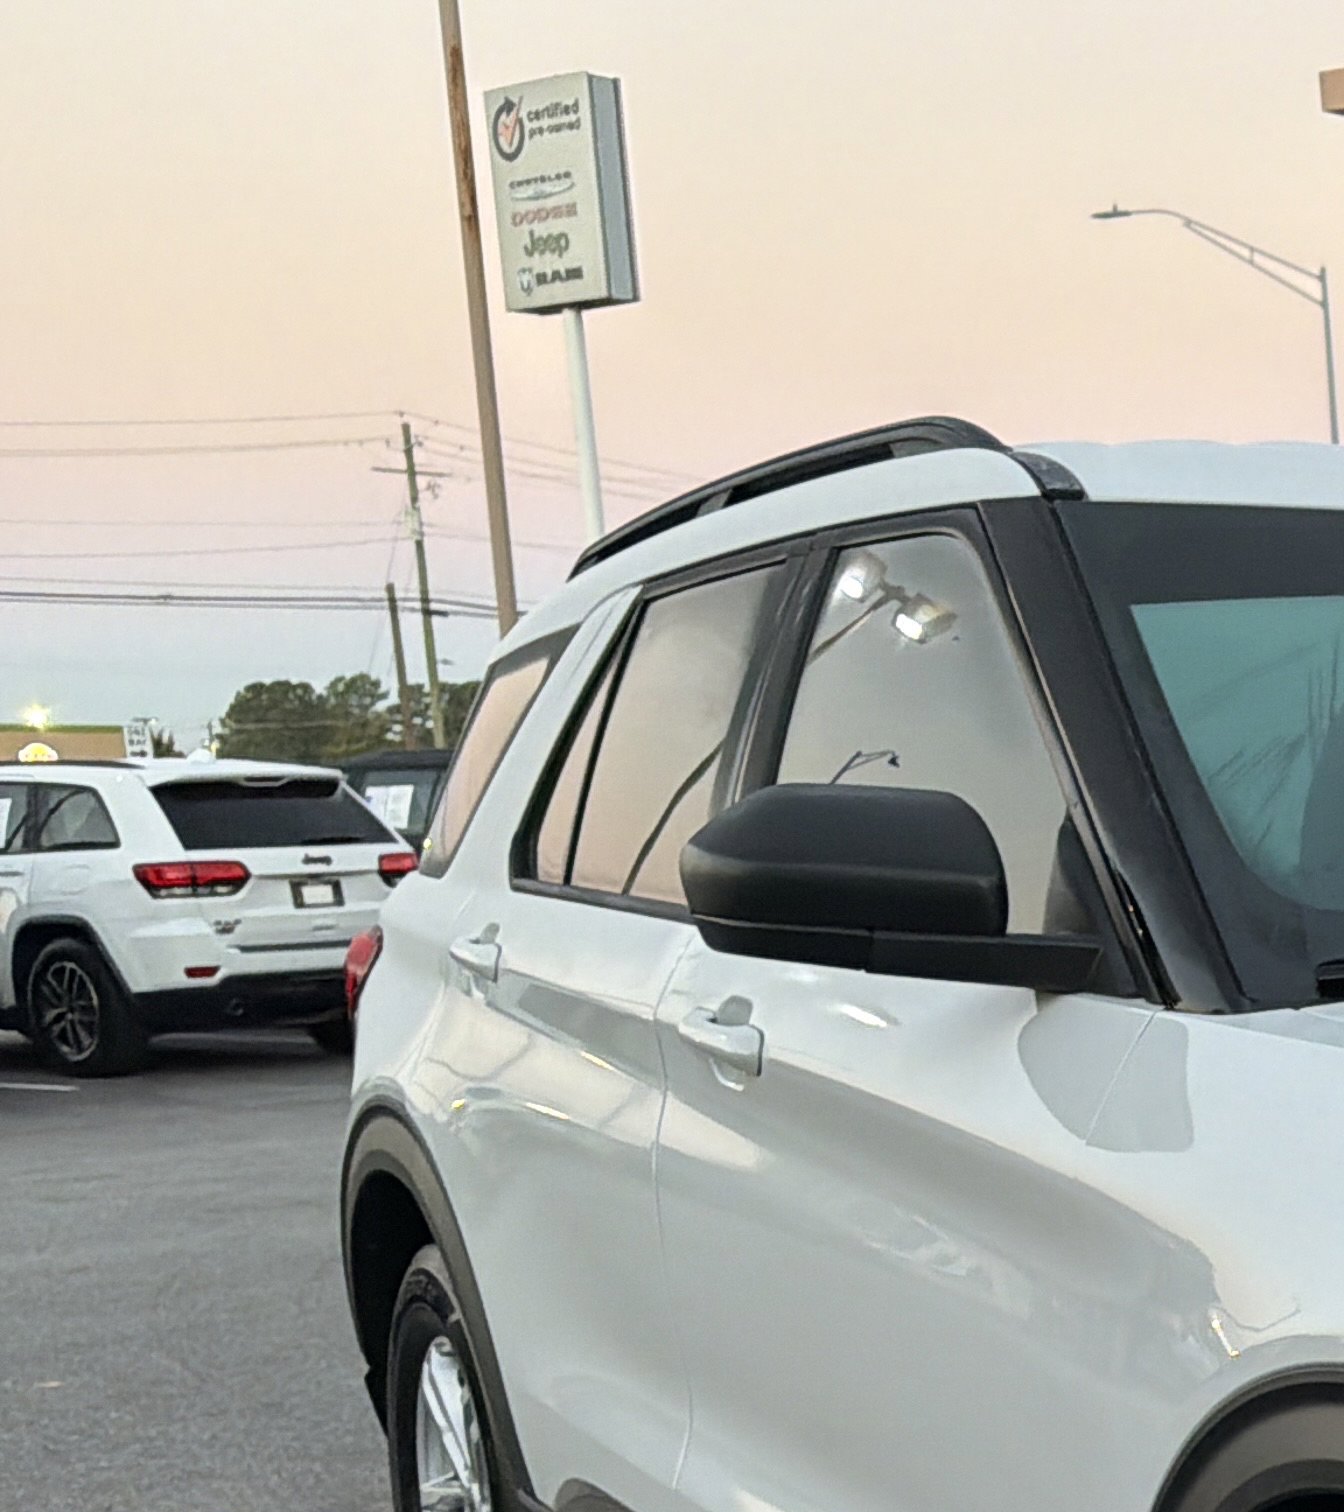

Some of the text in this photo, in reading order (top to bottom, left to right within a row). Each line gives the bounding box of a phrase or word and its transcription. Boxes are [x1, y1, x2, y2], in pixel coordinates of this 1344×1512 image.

[527, 97, 579, 122] certified
[528, 116, 581, 140] pre-owned
[523, 229, 569, 258] Jeep
[535, 266, 584, 287] RAM
